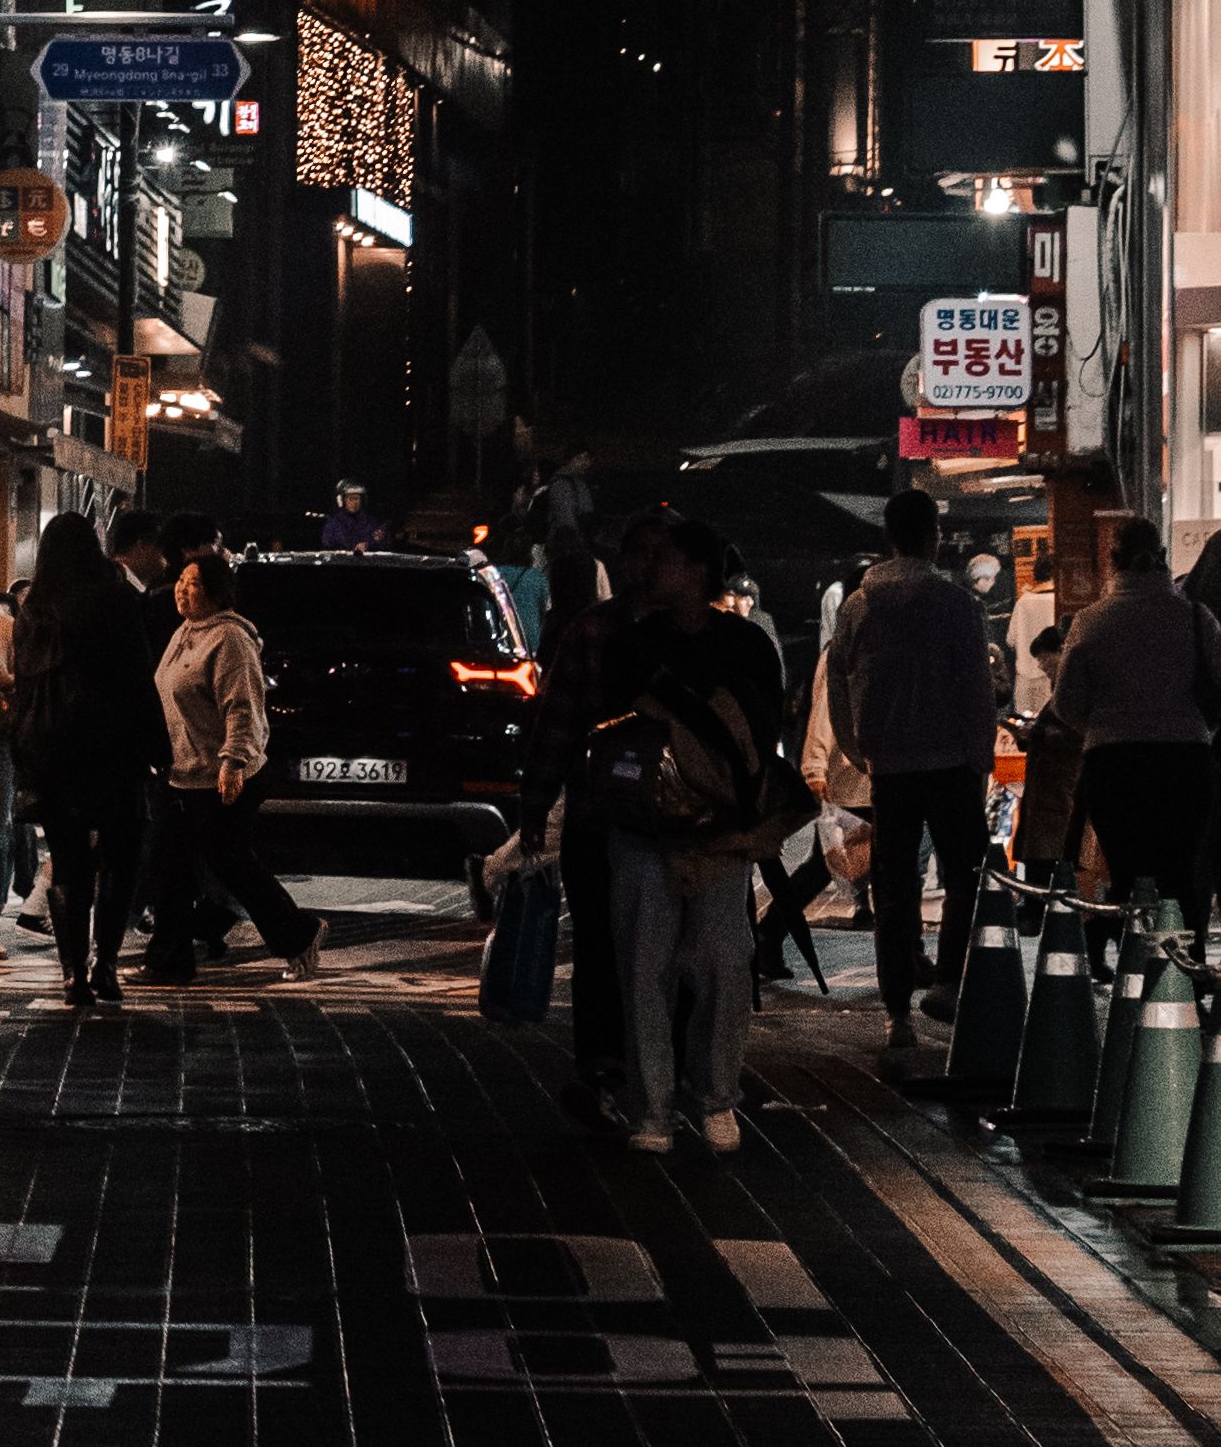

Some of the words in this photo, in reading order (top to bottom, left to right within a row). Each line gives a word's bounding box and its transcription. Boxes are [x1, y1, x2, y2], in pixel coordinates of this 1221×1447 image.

[52, 63, 69, 78] 29
[74, 68, 159, 83] Myeongdong
[936, 308, 1020, 331] 명동대운
[932, 337, 1025, 377] 부동산
[933, 384, 1023, 400] 02)775-9700
[919, 420, 998, 445] HAIR
